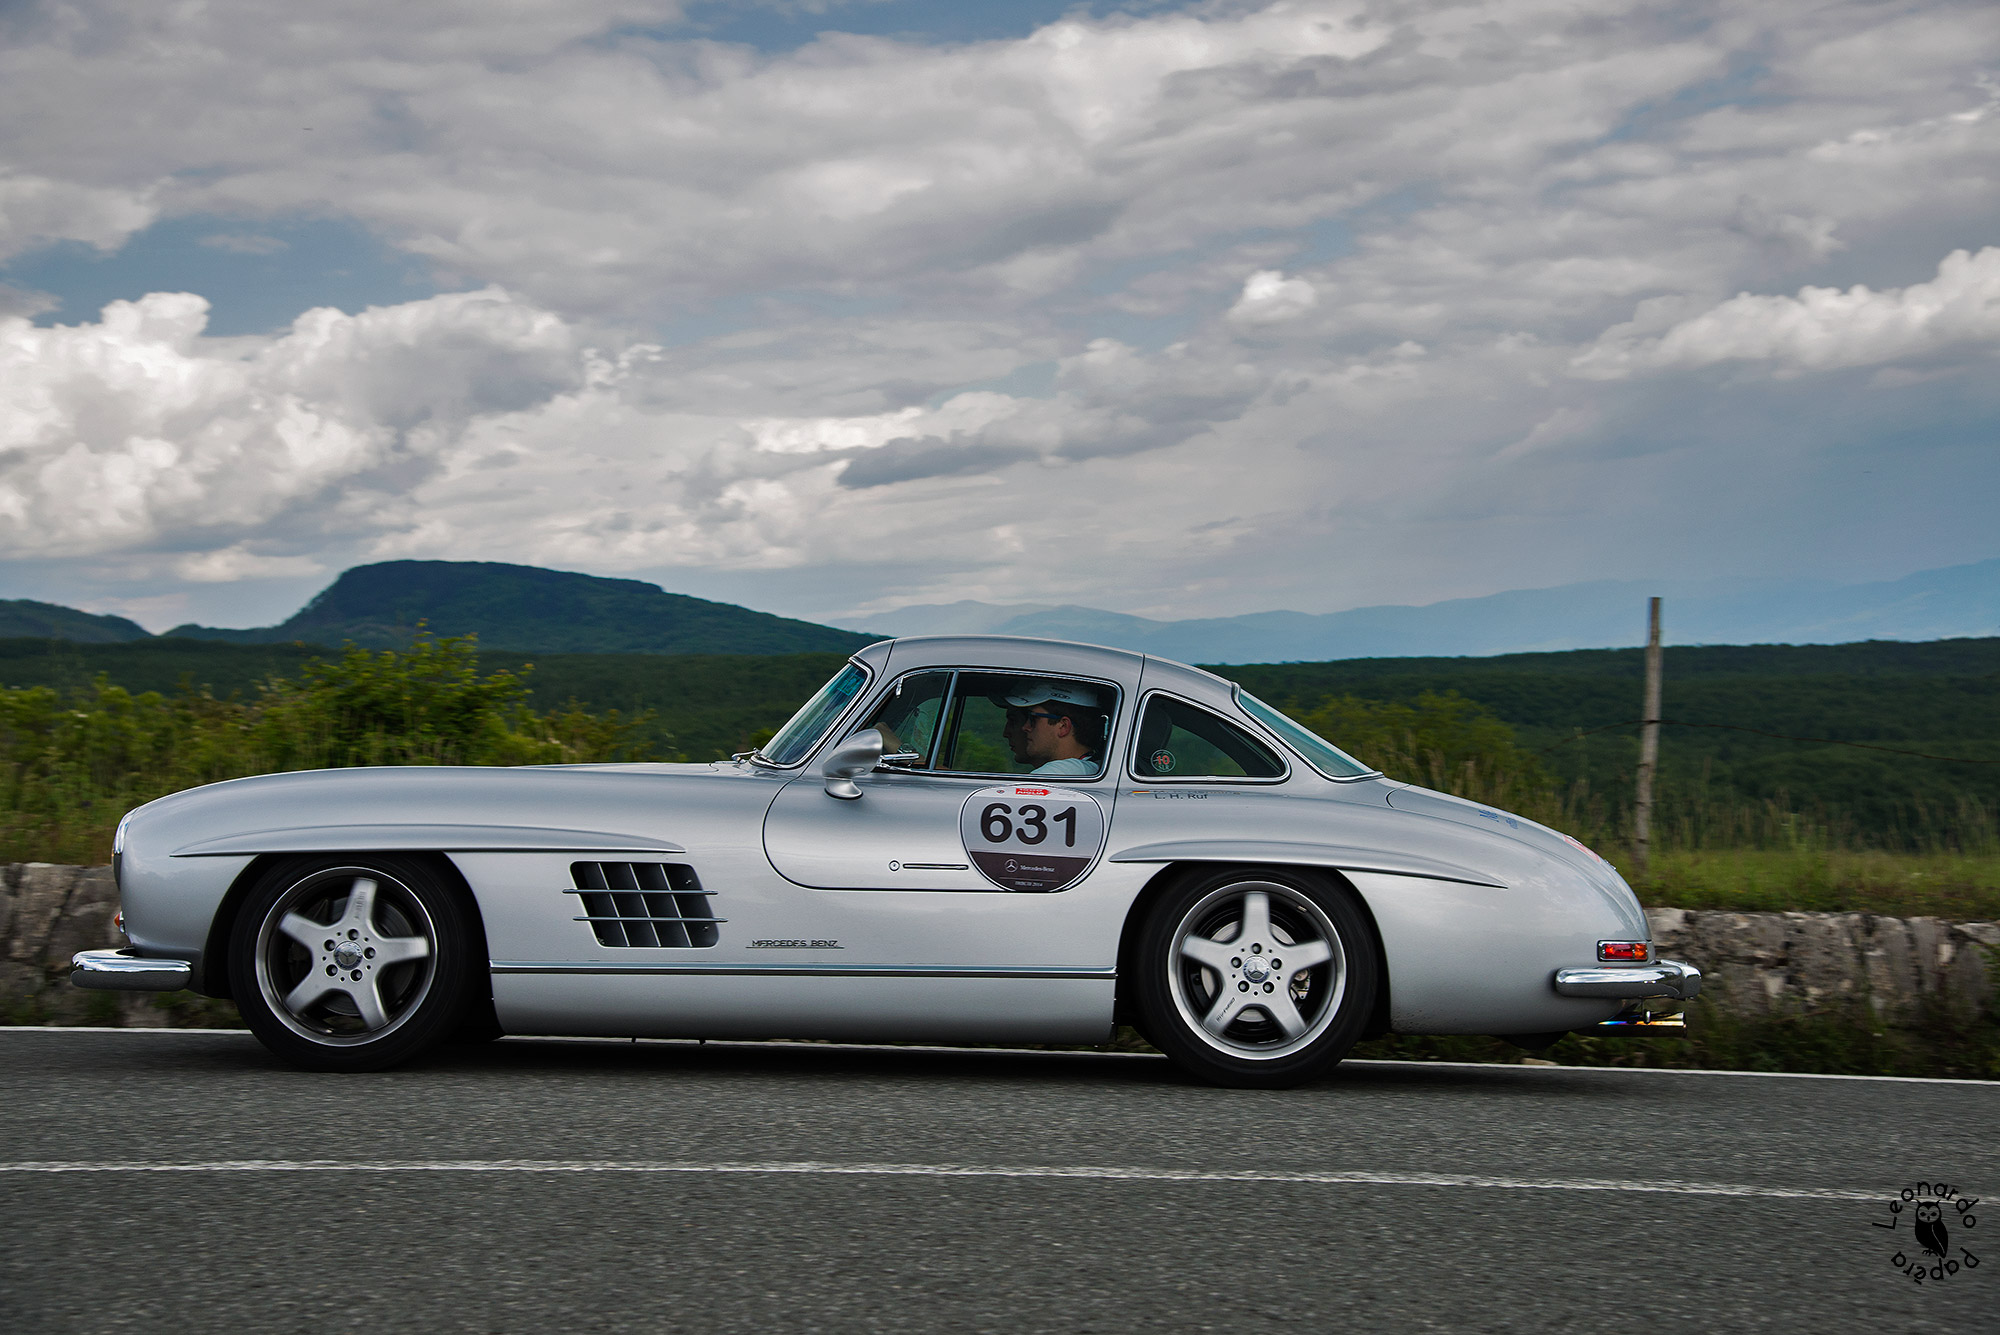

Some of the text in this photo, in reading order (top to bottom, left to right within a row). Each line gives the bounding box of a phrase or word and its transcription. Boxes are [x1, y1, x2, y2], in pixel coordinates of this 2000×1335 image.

[1157, 755, 1170, 765] 10
[980, 803, 1076, 848] 631
[1020, 865, 1055, 873] Mercedes-Benz
